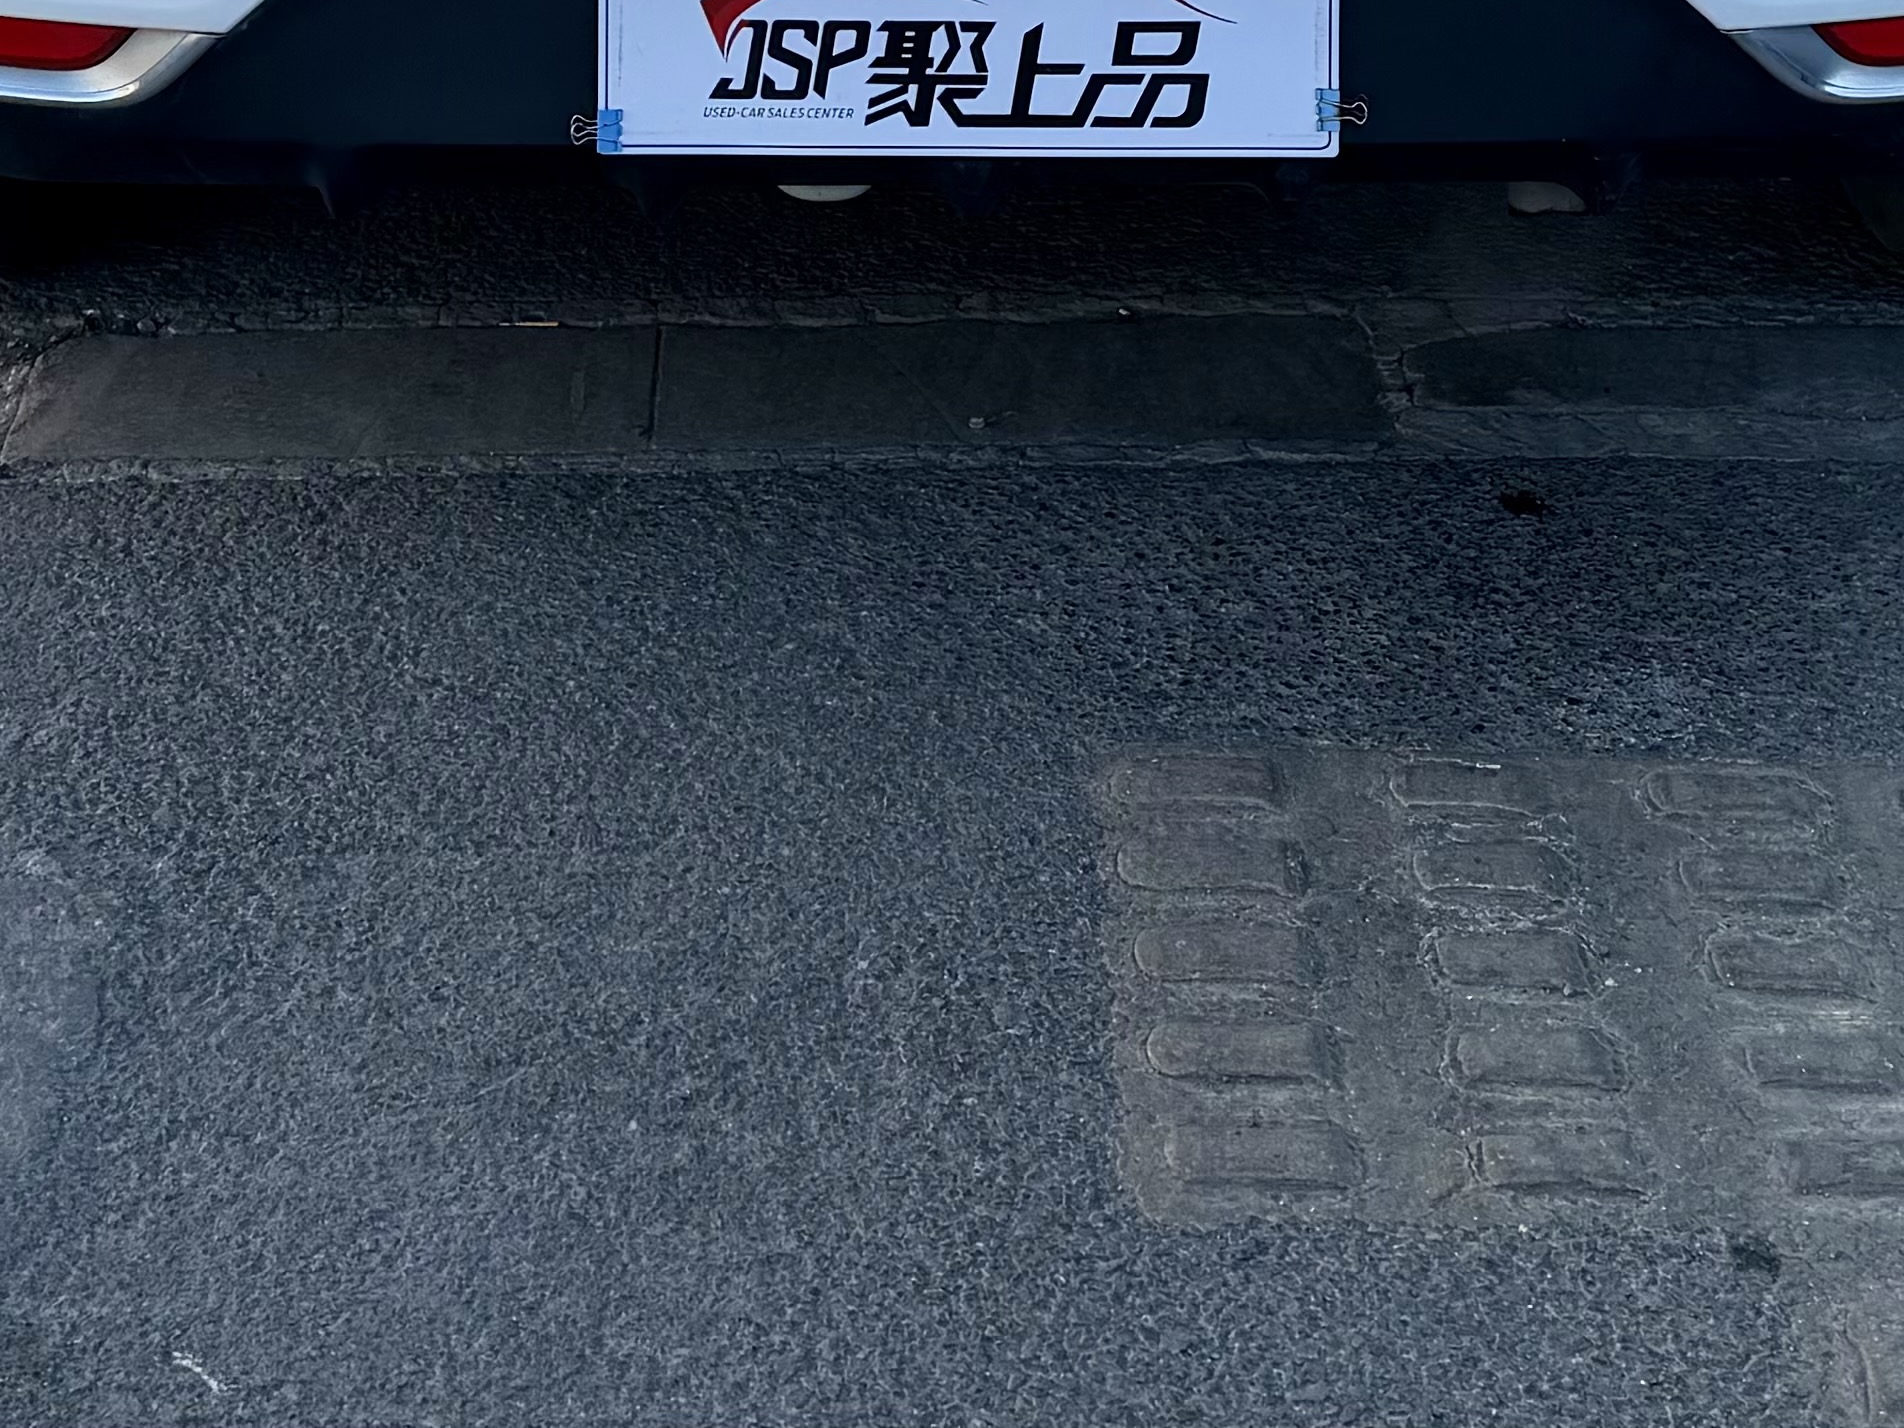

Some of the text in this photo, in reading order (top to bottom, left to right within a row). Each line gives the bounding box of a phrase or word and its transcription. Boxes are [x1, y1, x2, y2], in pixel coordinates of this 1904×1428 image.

[709, 19, 1211, 129] JSP 聚上品
[767, 106, 808, 120] SALES
[808, 107, 855, 120] CENTER
